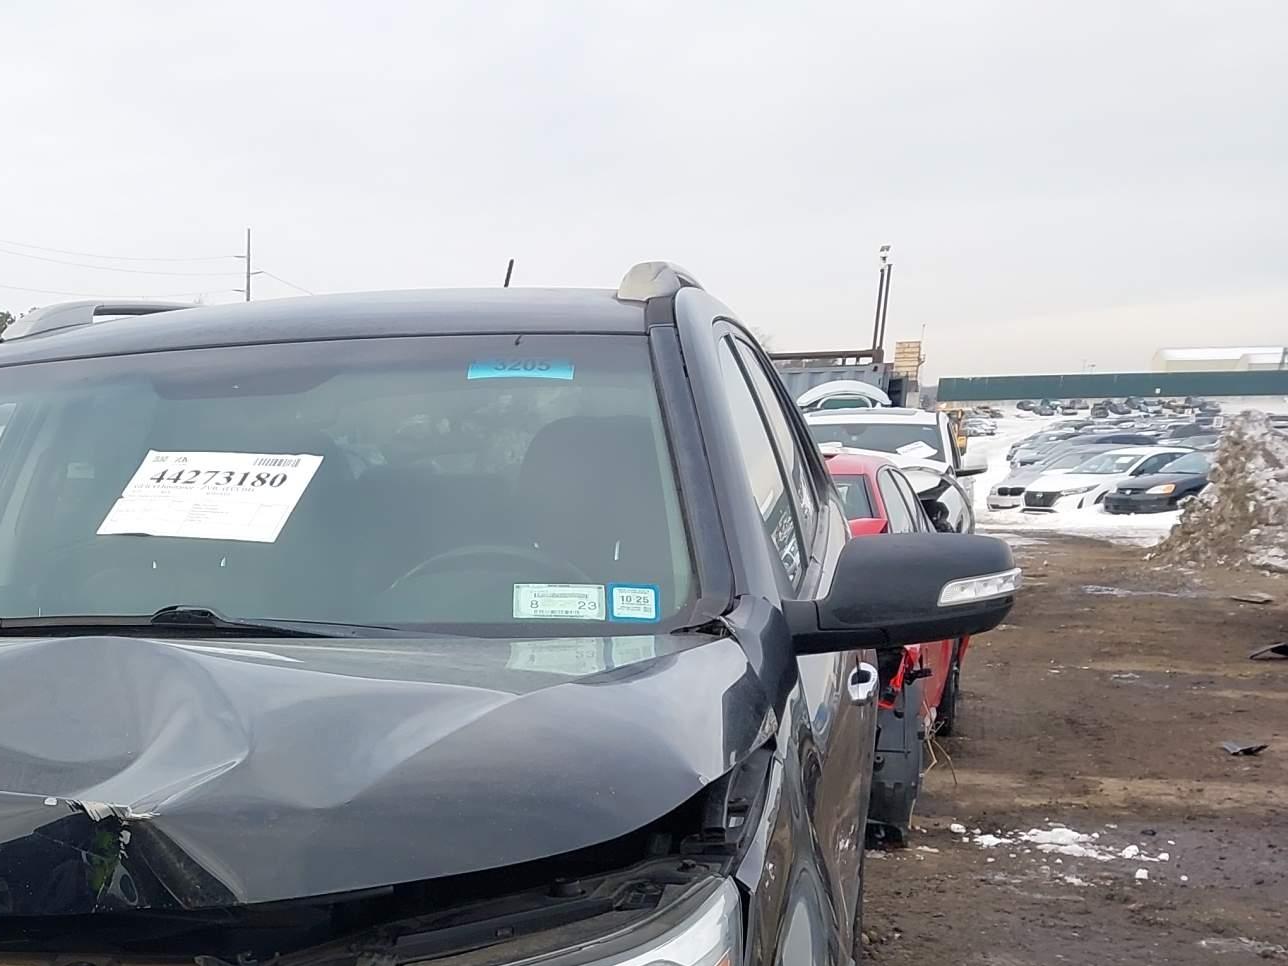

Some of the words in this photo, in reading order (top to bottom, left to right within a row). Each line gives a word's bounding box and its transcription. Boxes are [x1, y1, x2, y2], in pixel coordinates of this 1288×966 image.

[149, 468, 288, 489] 44273180
[530, 599, 540, 609] 8
[577, 600, 597, 611] 23
[620, 595, 632, 604] 10
[636, 595, 650, 605] 25
